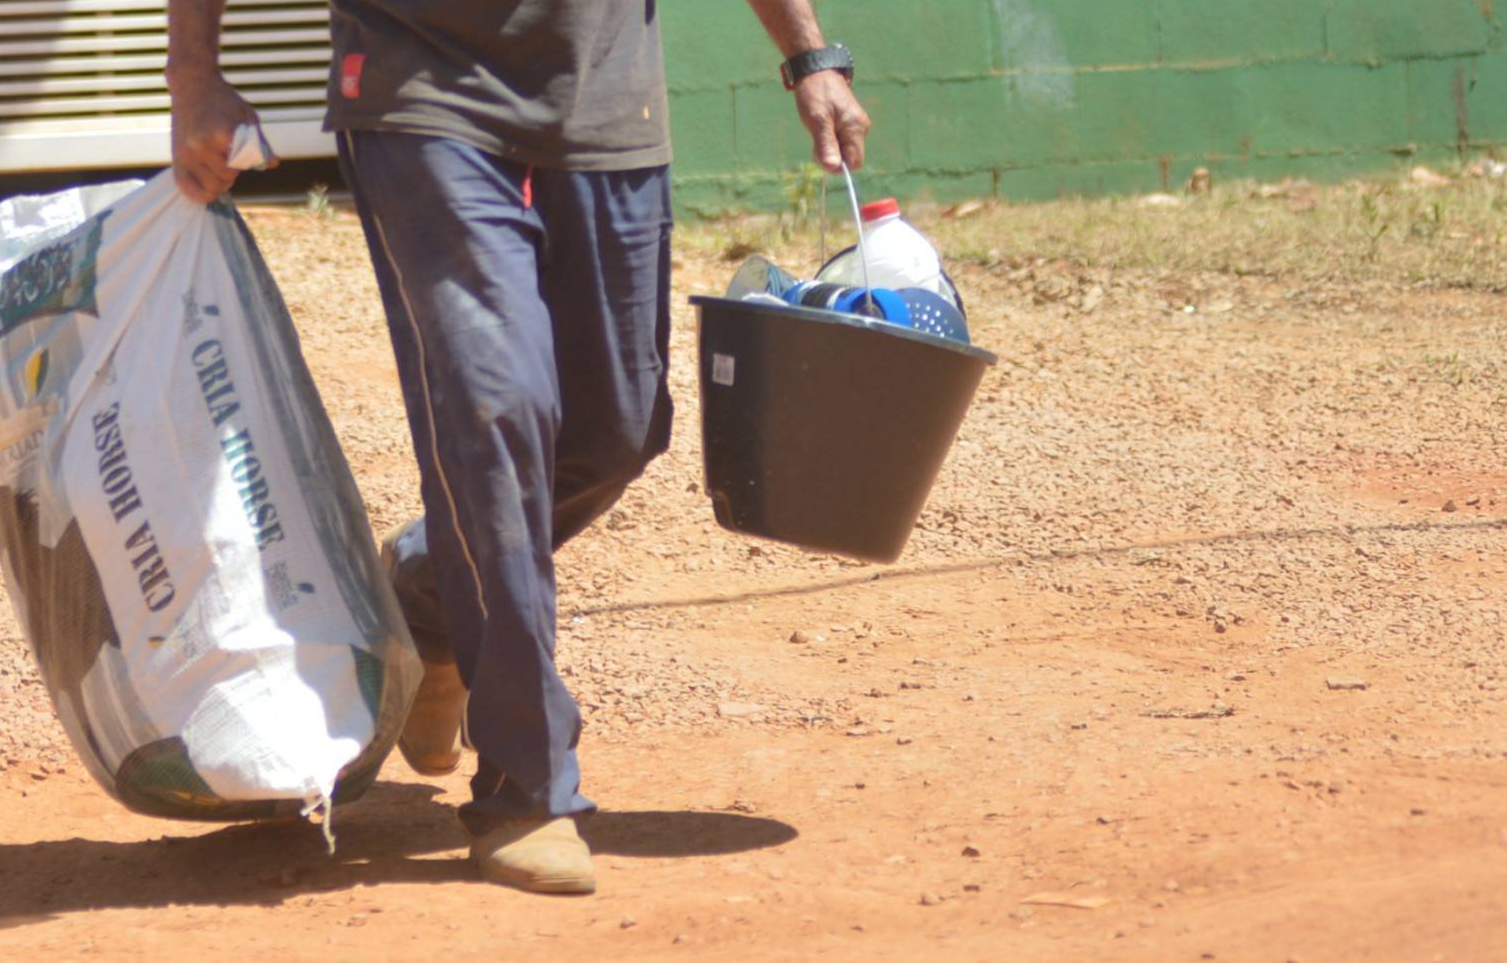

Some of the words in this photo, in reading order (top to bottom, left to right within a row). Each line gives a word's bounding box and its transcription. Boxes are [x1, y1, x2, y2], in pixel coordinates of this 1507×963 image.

[92, 401, 142, 524] HORSE
[191, 339, 241, 428] CRIA
[220, 428, 285, 552] HORSE
[124, 519, 176, 613] CRIA
